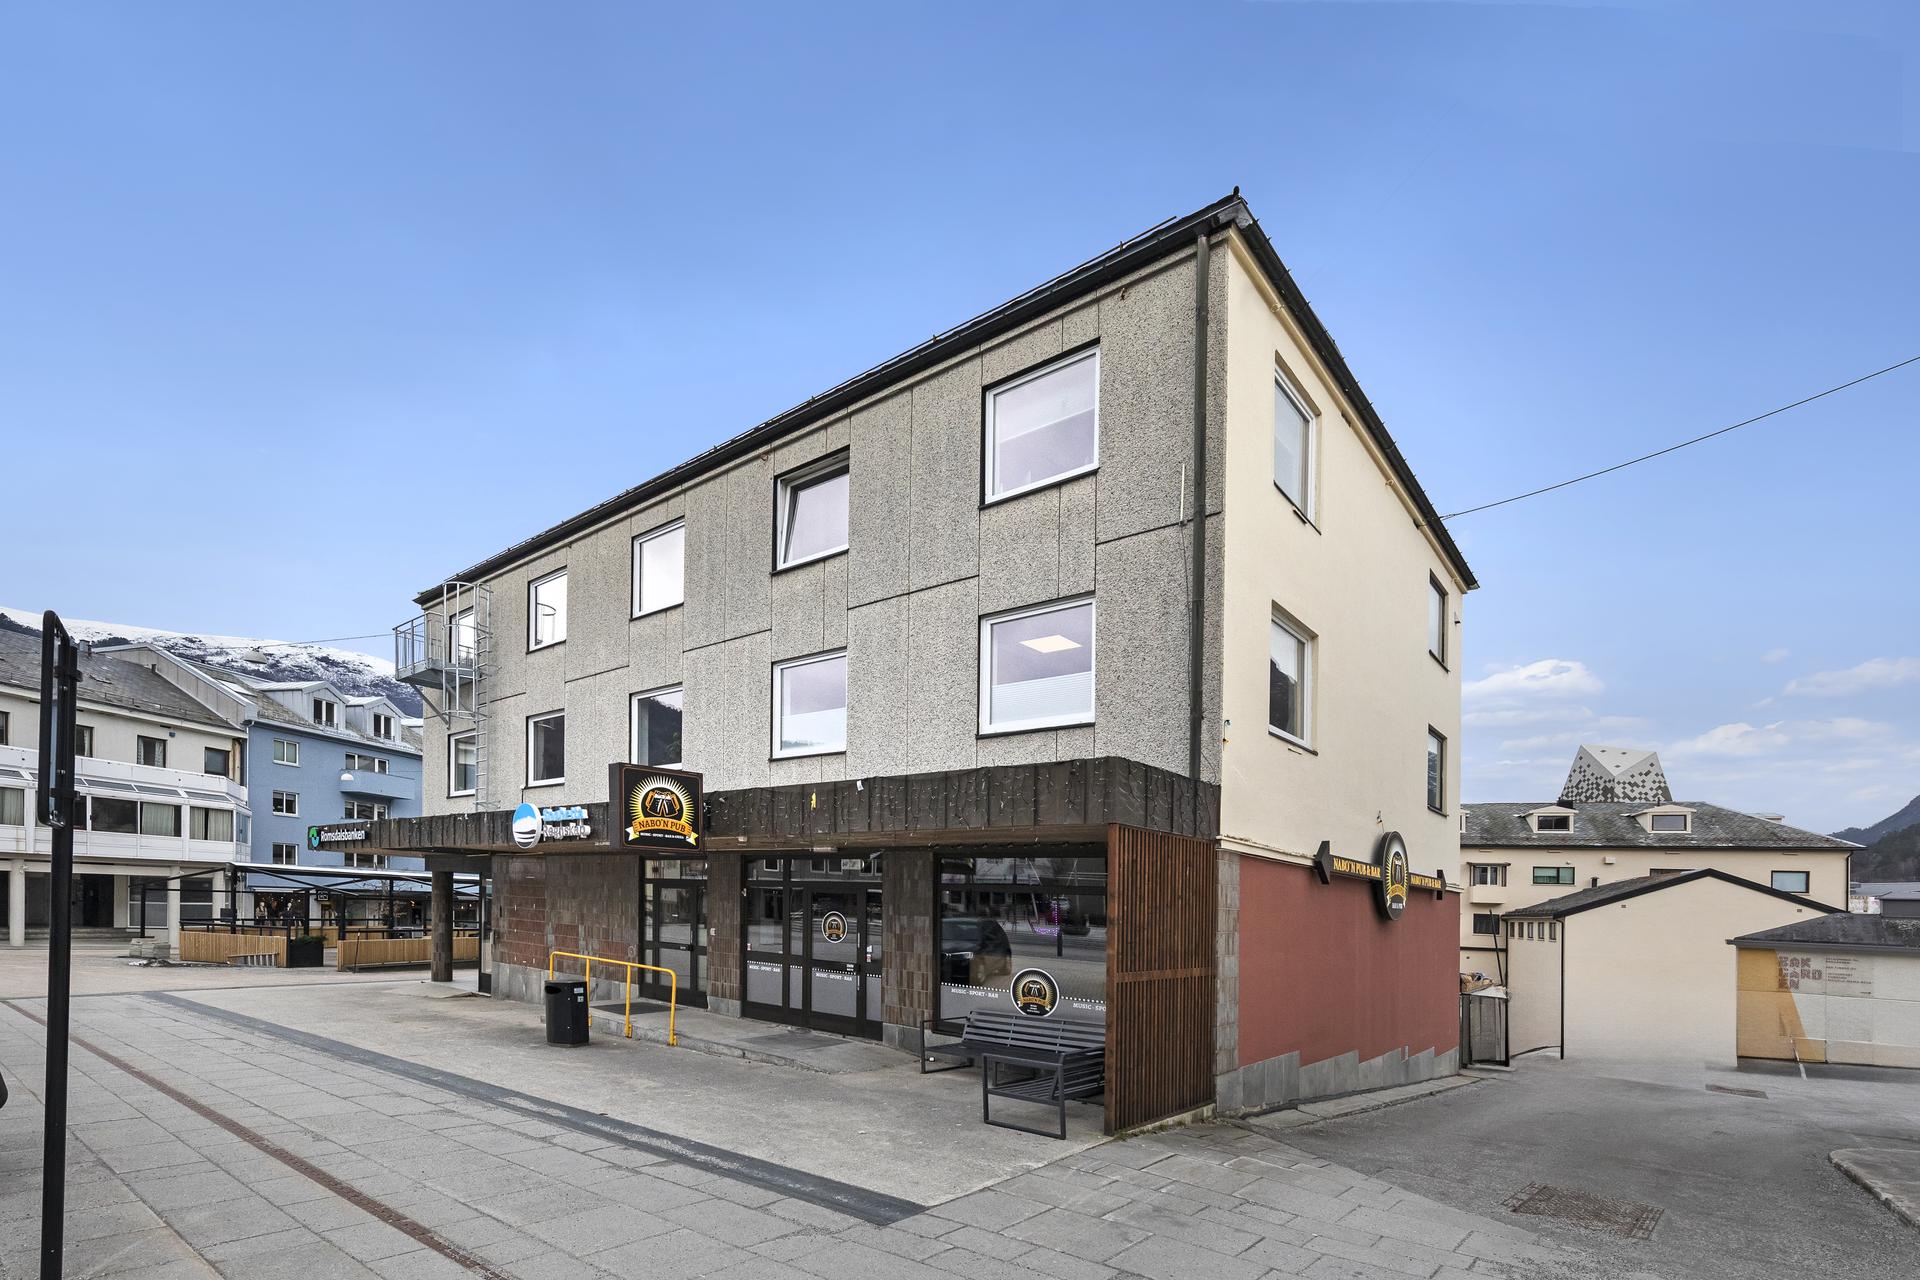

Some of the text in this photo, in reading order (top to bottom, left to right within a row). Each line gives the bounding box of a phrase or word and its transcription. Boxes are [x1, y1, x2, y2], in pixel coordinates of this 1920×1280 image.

[543, 822, 590, 840] Regnskap
[670, 821, 686, 833] PUB
[320, 828, 366, 842] Romsdalsbanken
[1356, 862, 1366, 875] PUB
[1371, 866, 1381, 878] BAR
[951, 987, 967, 995] MUSIC
[1072, 1002, 1092, 1010] MUSIC
